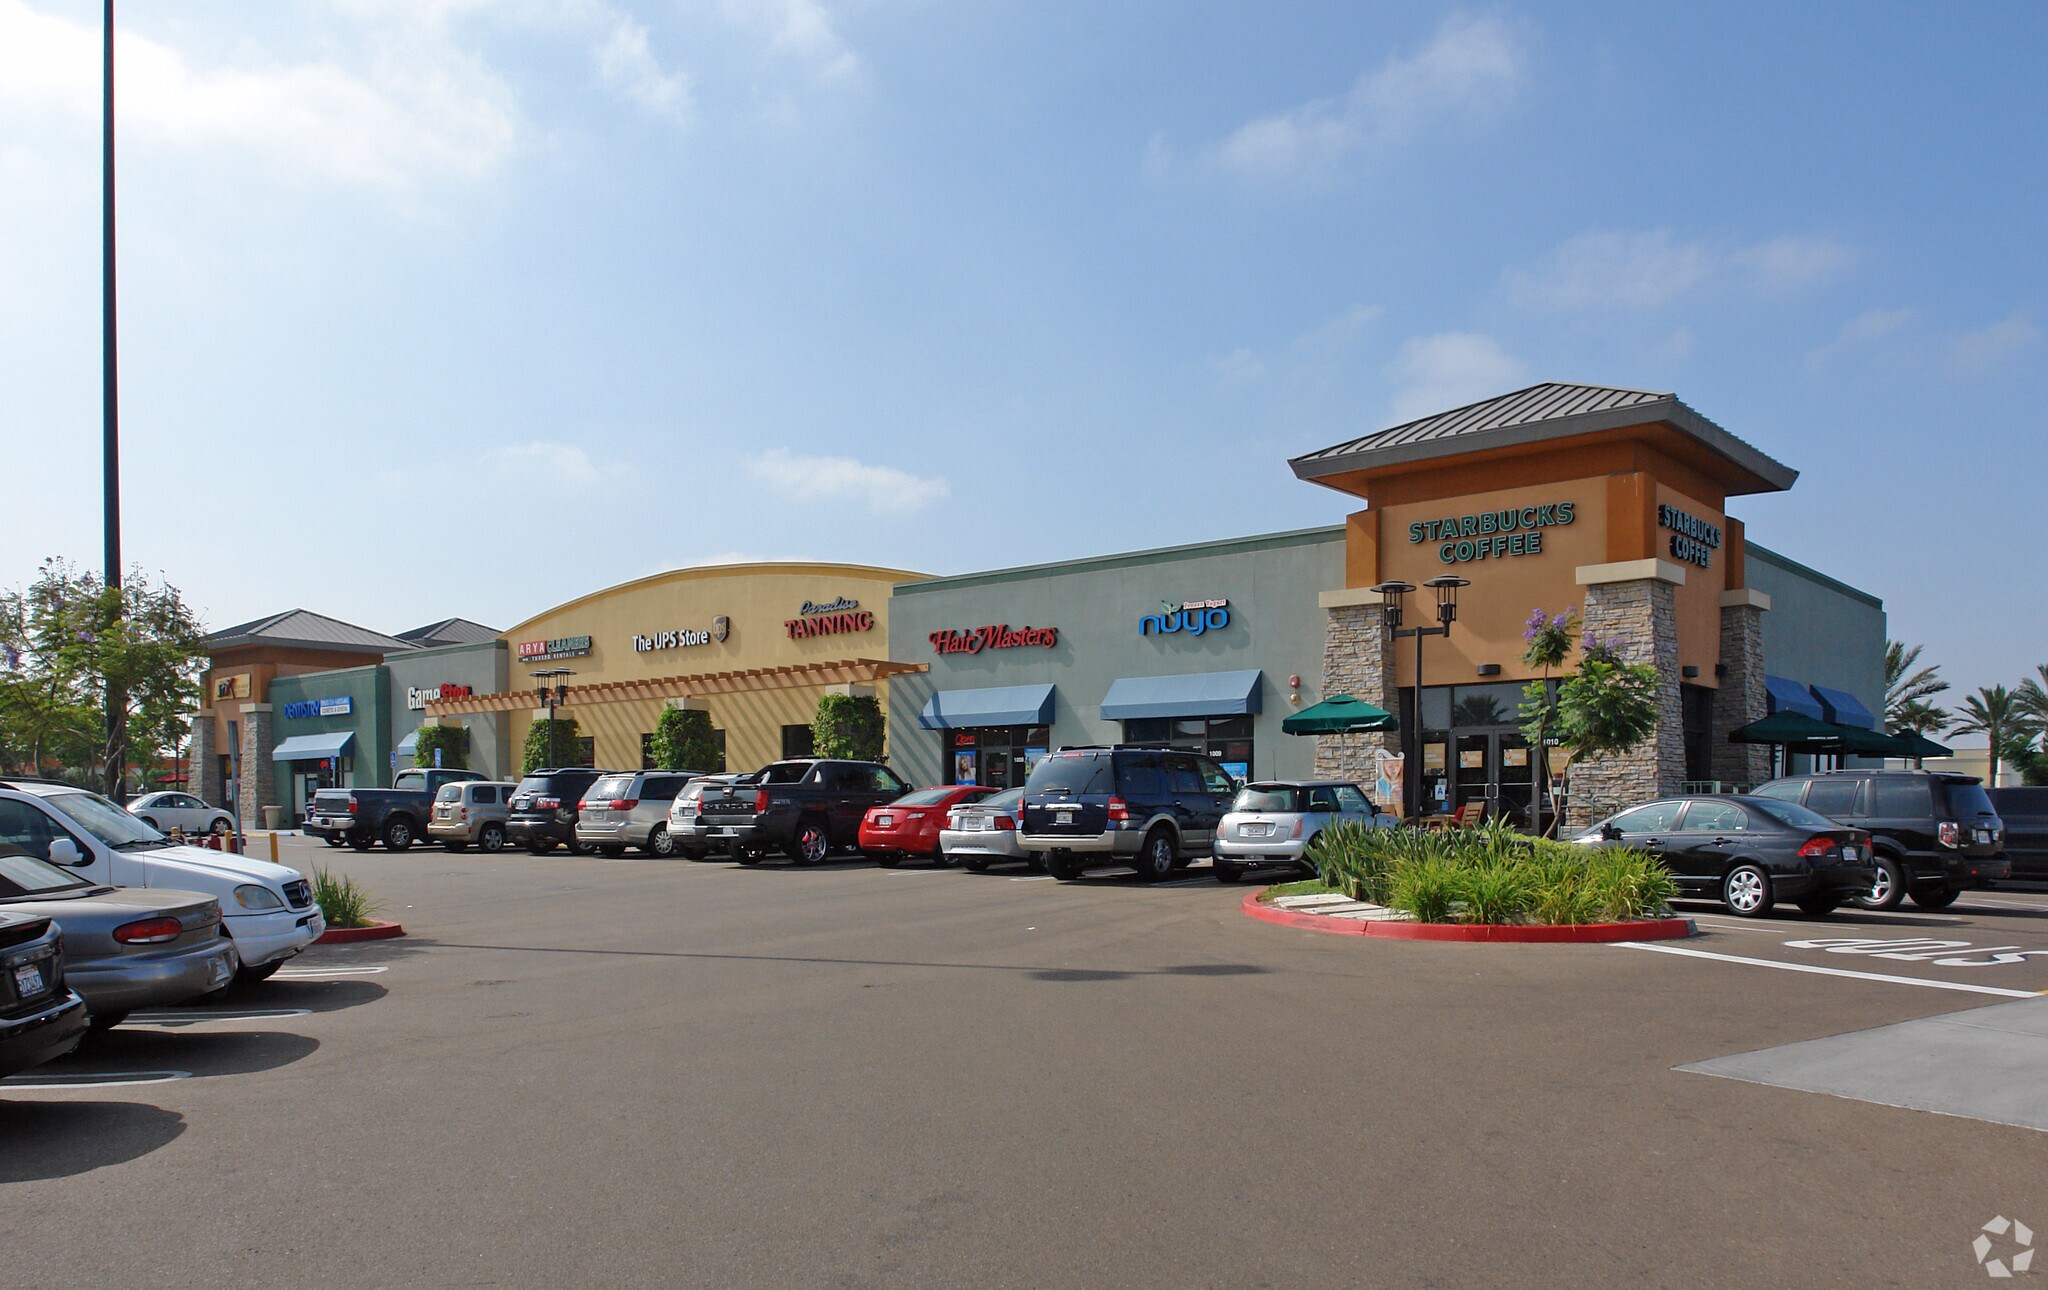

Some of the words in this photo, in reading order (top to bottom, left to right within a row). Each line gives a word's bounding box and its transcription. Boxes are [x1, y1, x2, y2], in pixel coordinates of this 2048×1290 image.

[1408, 502, 1574, 544] STARBUCKS
[1663, 504, 1722, 549] STARBUCKS
[1438, 531, 1541, 564] COFFEE
[1675, 535, 1712, 569] COFFEE
[800, 596, 859, 615] Paradise
[784, 611, 873, 639] TANNING
[1138, 608, 1228, 636] nuyo
[519, 641, 546, 655] ARYA
[546, 636, 590, 653] CLEANERS
[632, 635, 653, 652] The
[654, 631, 678, 650] UPS
[679, 629, 709, 647] Store
[929, 629, 977, 653] Hair
[975, 624, 1058, 649] Masters
[283, 700, 320, 719] DENTISTRY
[1543, 738, 1559, 746] 1010
[1437, 787, 1443, 795] A
